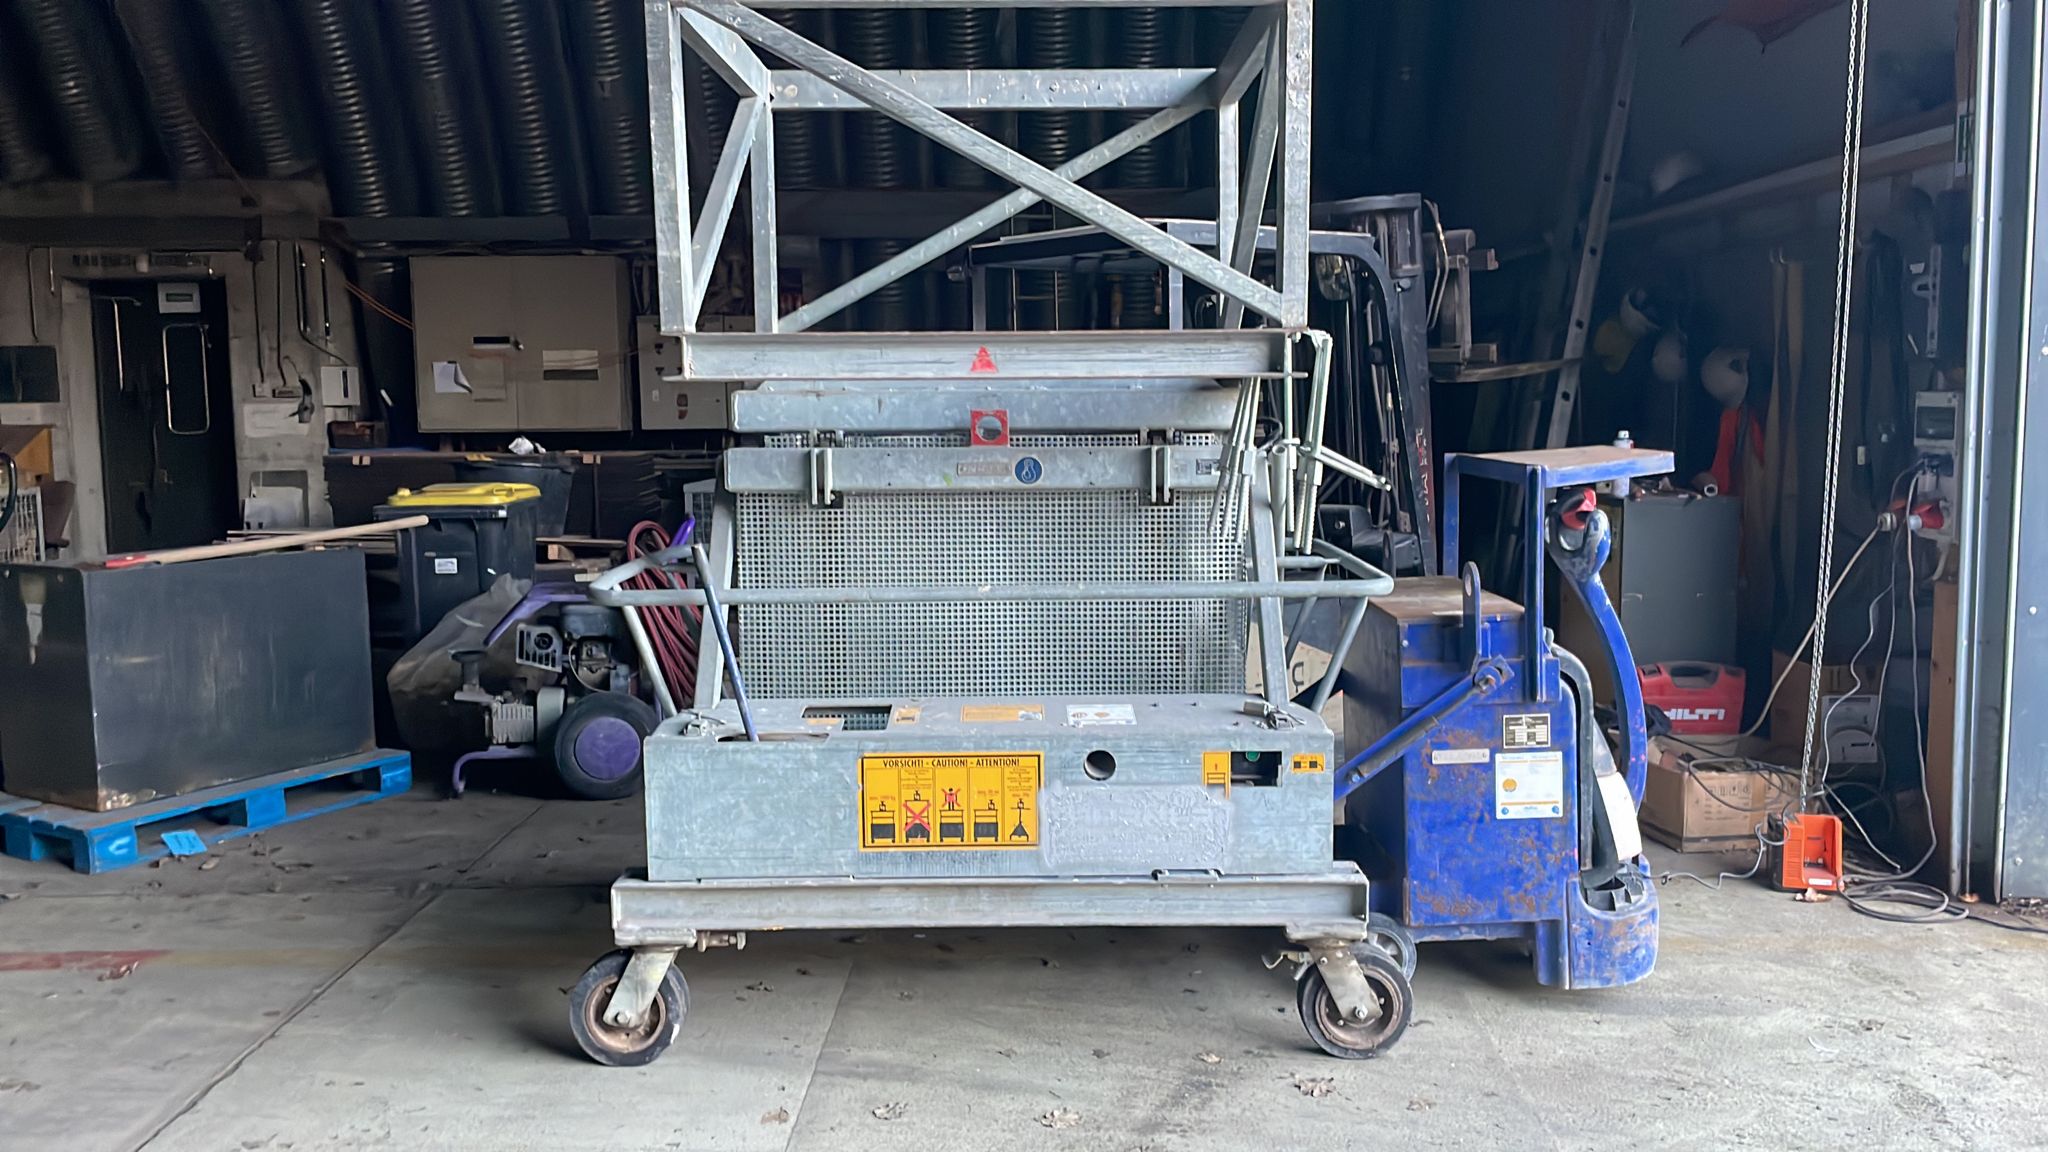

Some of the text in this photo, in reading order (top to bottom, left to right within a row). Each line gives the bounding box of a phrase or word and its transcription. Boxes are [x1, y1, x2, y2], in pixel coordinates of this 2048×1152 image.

[883, 759, 923, 768] VORSICHT!
[932, 759, 968, 768] CAUTION!
[976, 758, 1020, 767] ATTENTION!
